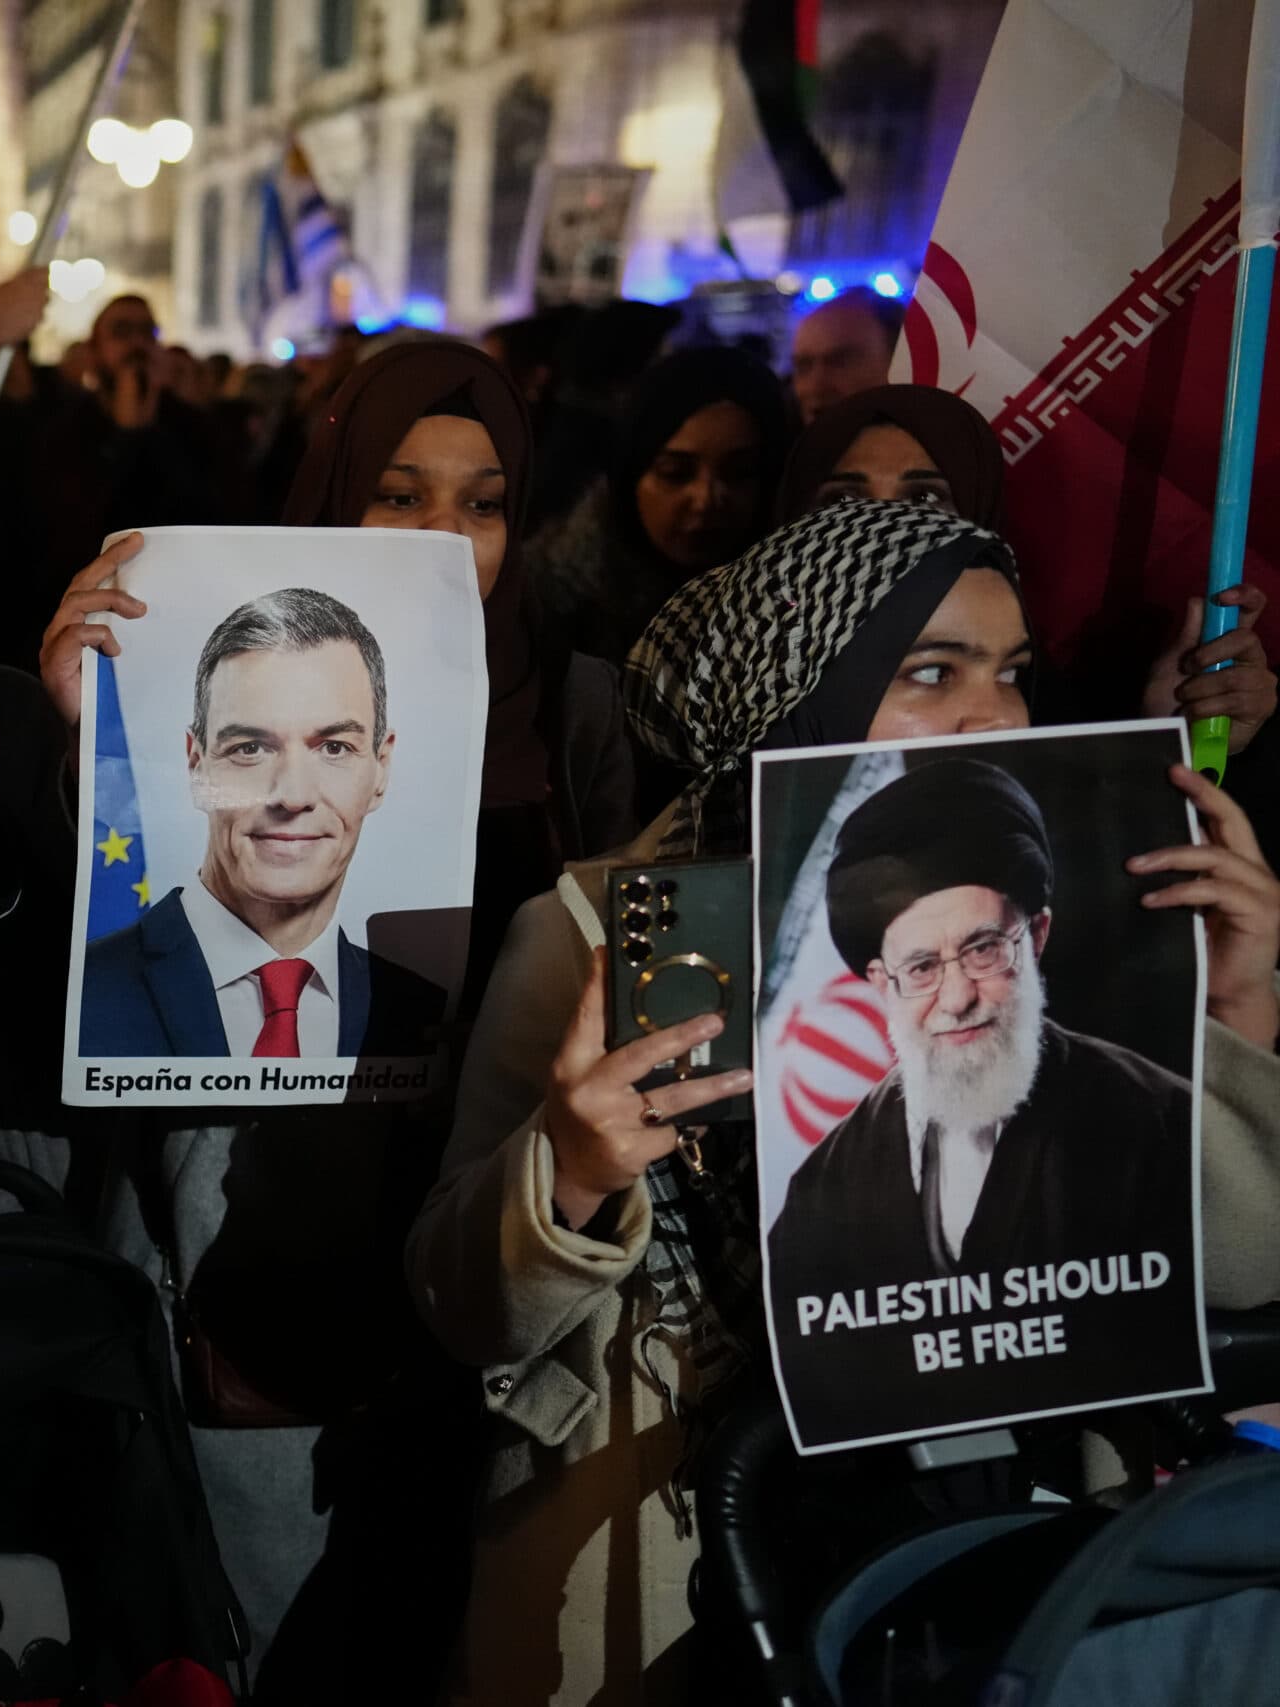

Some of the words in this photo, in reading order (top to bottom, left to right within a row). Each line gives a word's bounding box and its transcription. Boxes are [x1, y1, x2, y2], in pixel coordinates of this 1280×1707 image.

[85, 1066, 192, 1098] España
[200, 1074, 251, 1091] con
[260, 1064, 430, 1091] Humanidad
[797, 1272, 992, 1337] PALESTIN
[1002, 1250, 1171, 1308] SHOULD
[912, 1328, 964, 1373] BE
[971, 1314, 1067, 1364] FREE
